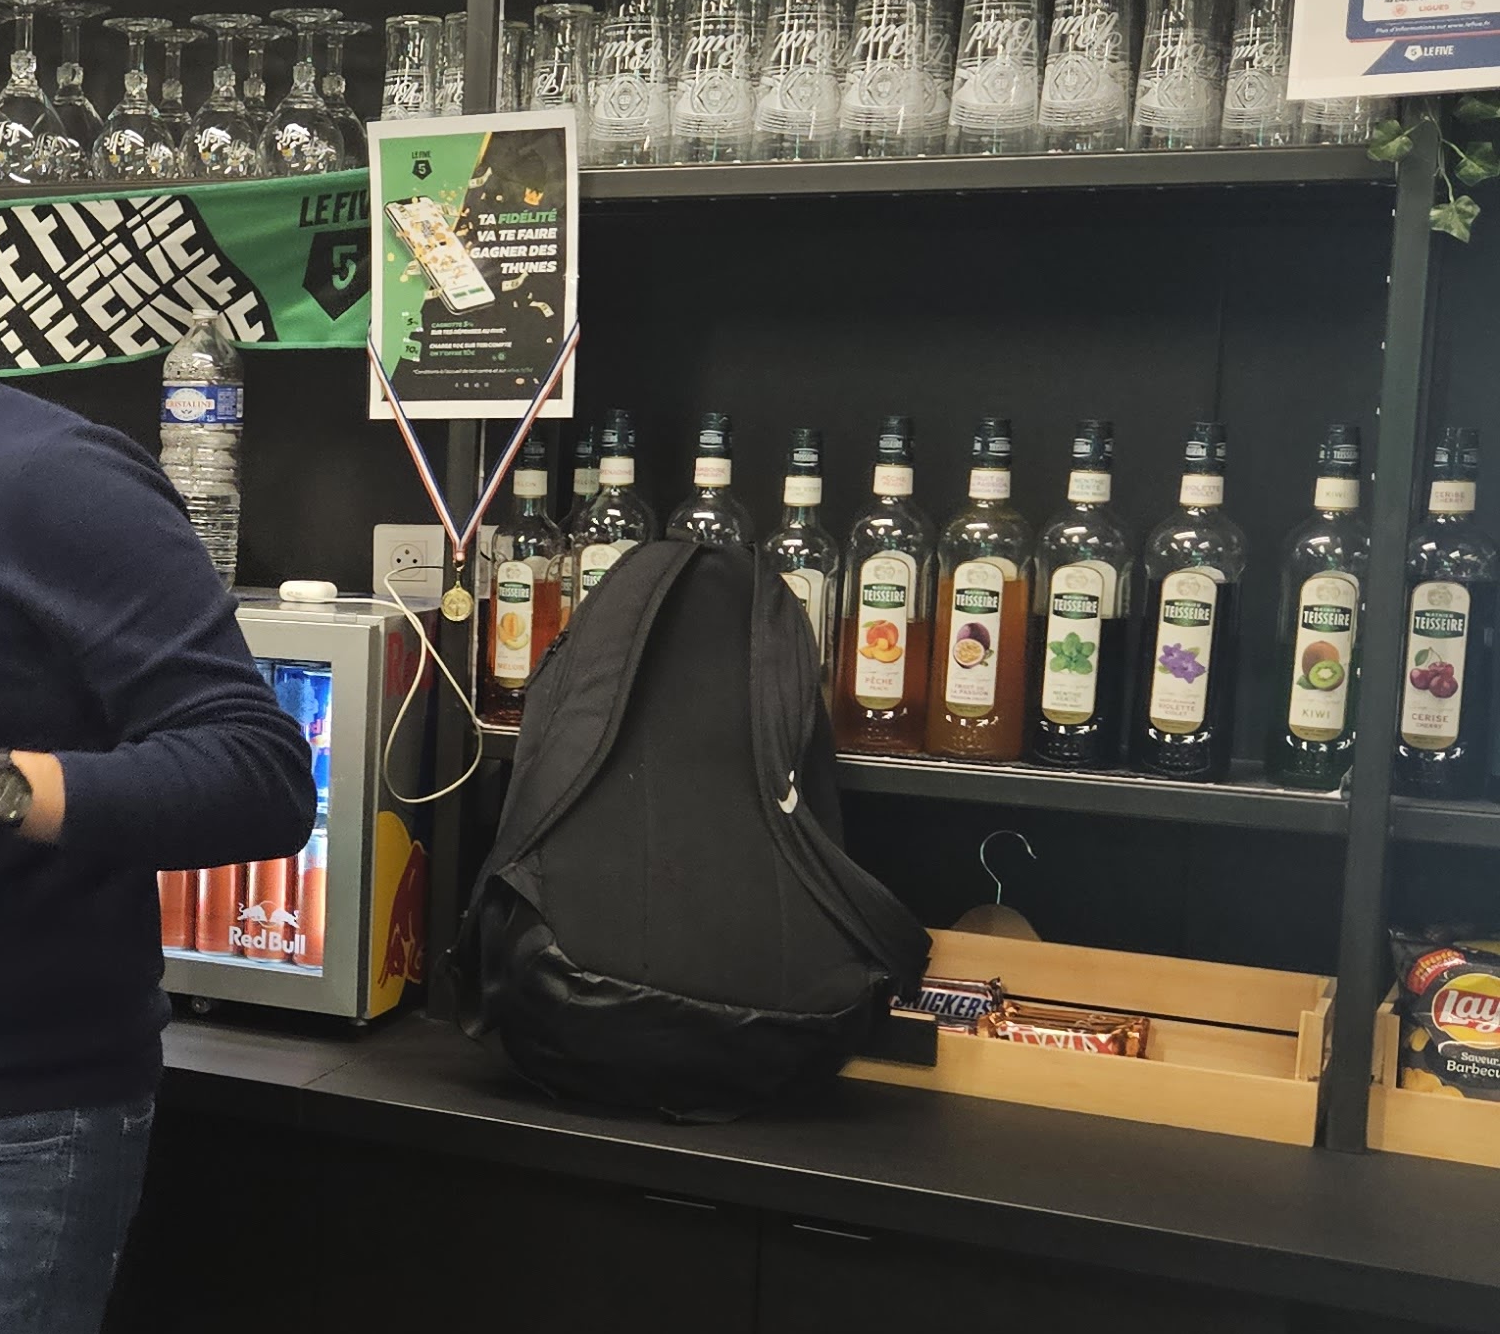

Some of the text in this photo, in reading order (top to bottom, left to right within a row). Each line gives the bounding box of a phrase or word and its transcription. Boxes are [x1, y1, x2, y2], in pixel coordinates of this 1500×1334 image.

[1424, 45, 1454, 57] LE FIVE
[418, 164, 426, 174] 5
[300, 189, 368, 228] LE FIV
[478, 215, 496, 225] TA
[477, 228, 557, 241] VA TE FAIRE
[470, 244, 557, 258] GAGNER DES
[332, 244, 357, 289] 5
[500, 261, 557, 274] THUNES
[863, 589, 905, 603] TEISSEIRE
[956, 594, 998, 609] TEISSEIRE
[1054, 598, 1097, 614] TEISSEIRE
[1164, 604, 1211, 621] TEISSEIRE
[1302, 610, 1350, 627] TEISSEIRE
[1414, 615, 1464, 633] TEISSEIRE
[1302, 708, 1331, 720] KIWI
[1411, 712, 1450, 723] CERISE
[228, 925, 306, 955] Red Bull
[1439, 989, 1500, 1032] Lay
[1446, 1060, 1500, 1079] Barbecu
